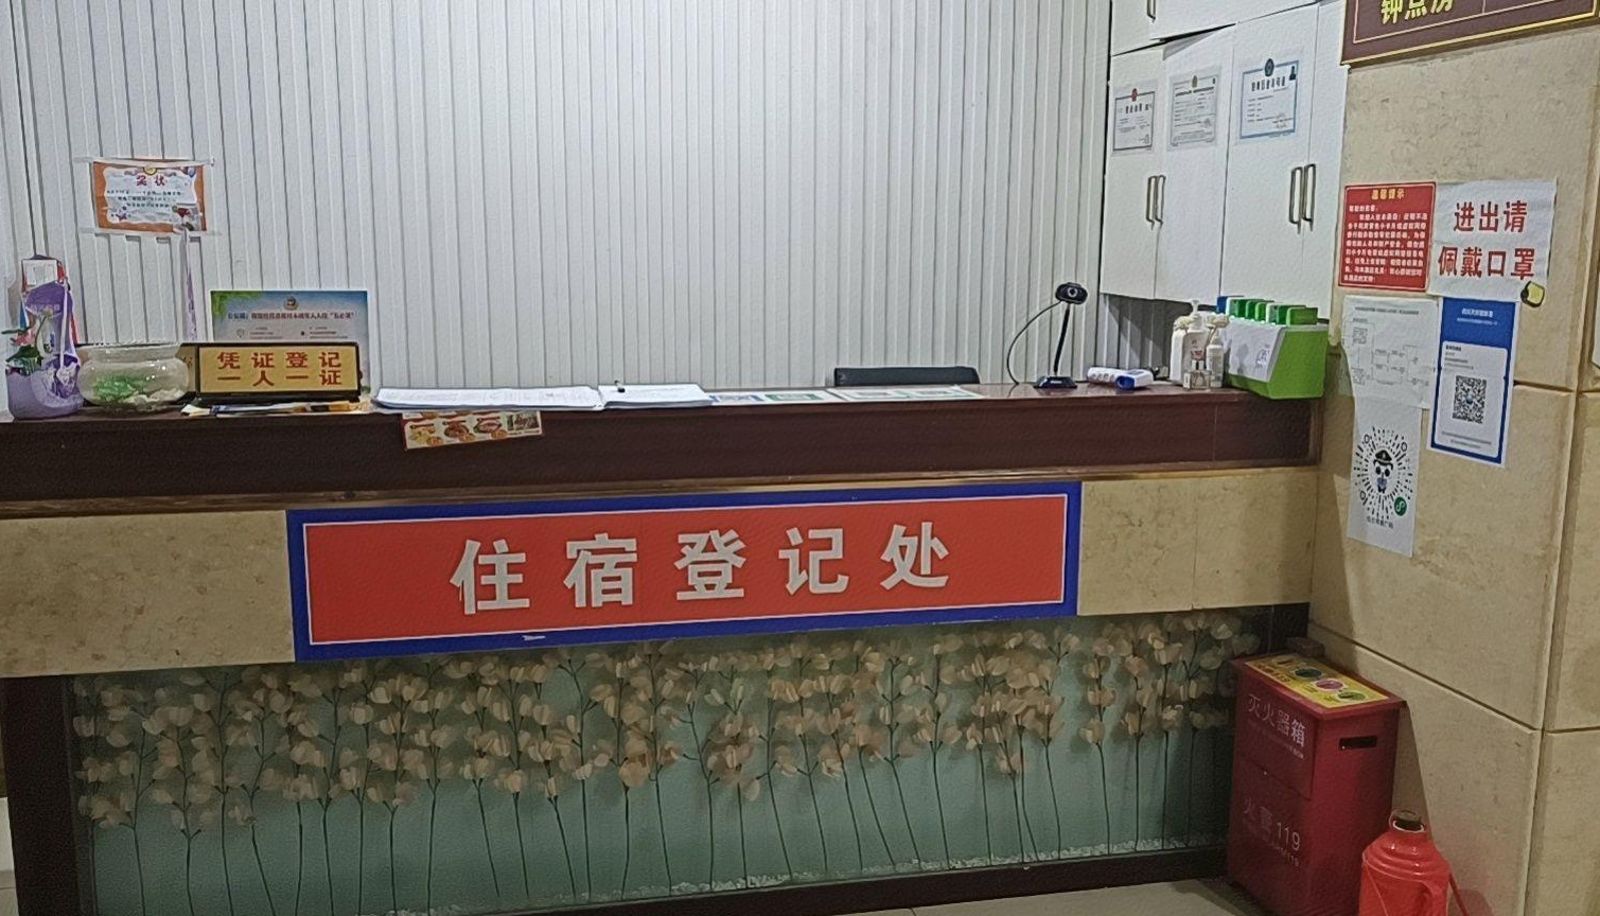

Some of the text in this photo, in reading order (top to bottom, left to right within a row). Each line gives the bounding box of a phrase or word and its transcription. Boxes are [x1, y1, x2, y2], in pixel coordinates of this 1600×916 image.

[1453, 200, 1528, 233] 进出请
[1438, 246, 1535, 280] 佩戴口罩
[217, 351, 342, 370] 凭证登记
[217, 370, 342, 387] 一人一证
[449, 521, 949, 614] 住宿登记处
[1248, 694, 1305, 747] 灭火器箱
